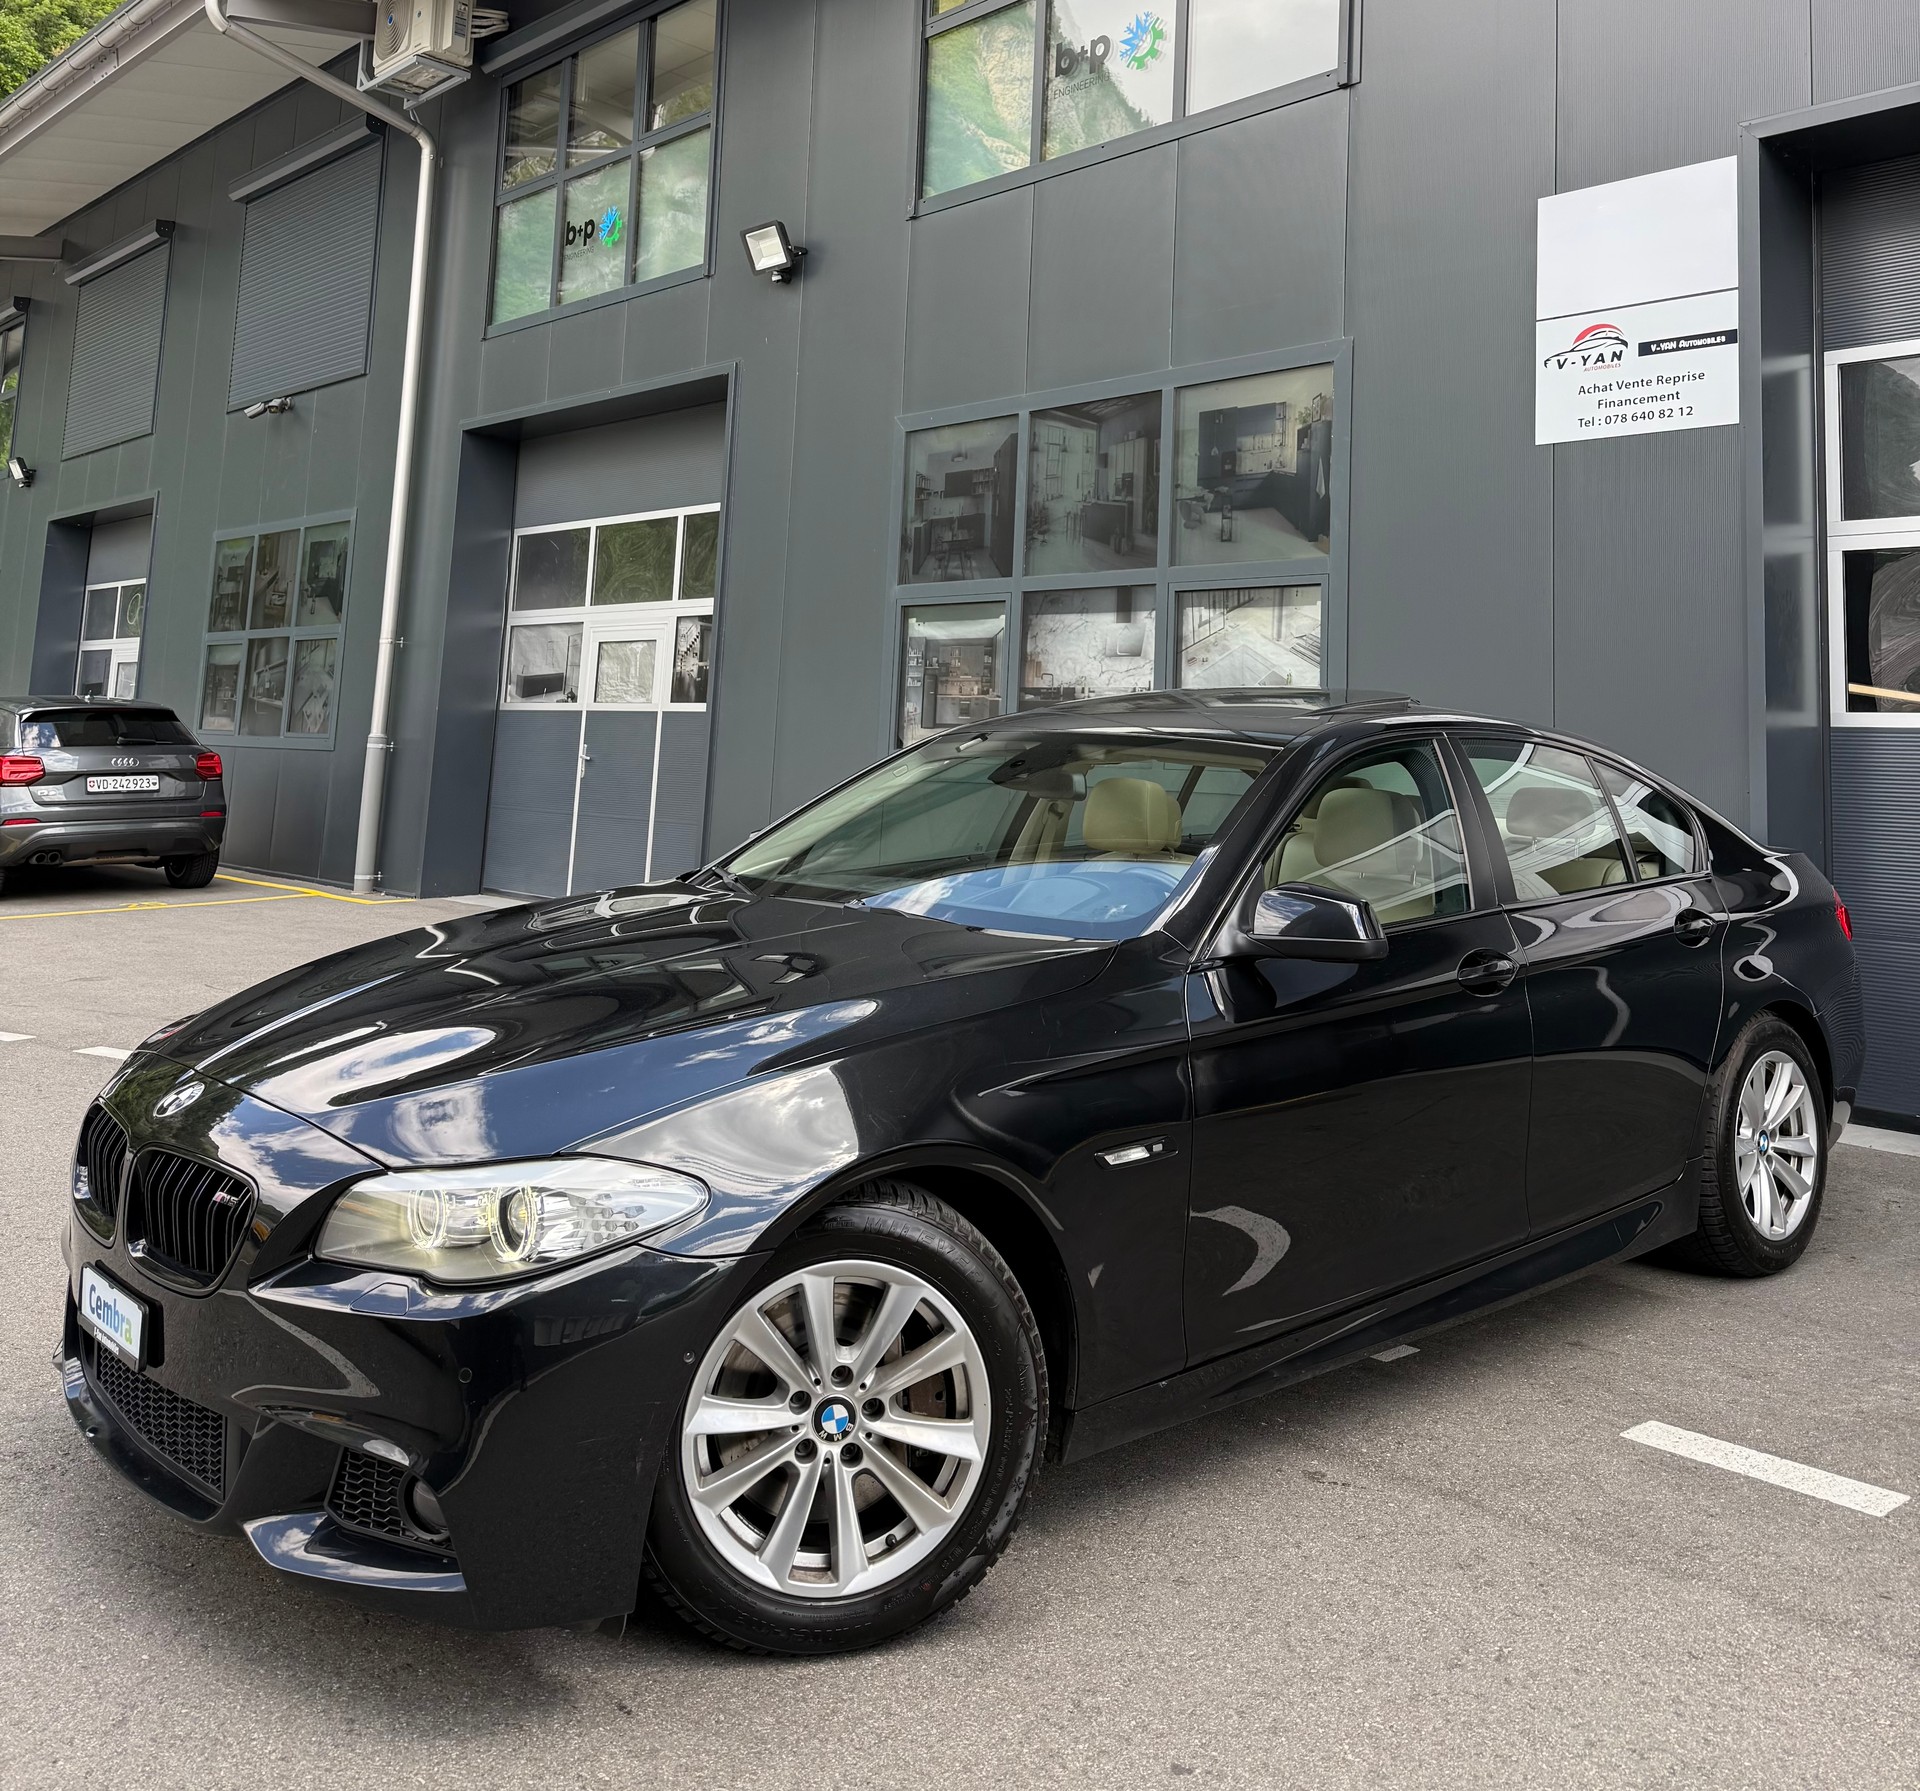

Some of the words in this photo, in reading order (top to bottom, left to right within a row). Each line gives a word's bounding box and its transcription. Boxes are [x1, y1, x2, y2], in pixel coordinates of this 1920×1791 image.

[1055, 35, 1111, 78] b+p
[1053, 72, 1110, 100] ENGINEERING
[565, 219, 595, 246] b+p
[1650, 340, 1676, 352] V-YAN
[1556, 350, 1623, 370] V-YAN
[1583, 363, 1621, 372] AUTOMOBILES
[1578, 382, 1613, 396] Achat
[1616, 377, 1653, 392] Vente
[1656, 371, 1705, 387] Reprise
[1597, 391, 1680, 409] Financement
[1604, 414, 1628, 425] 078
[1631, 410, 1655, 422] 640
[1658, 408, 1674, 419] 82
[1679, 406, 1694, 417] 12
[89, 1284, 132, 1345] Cembra
